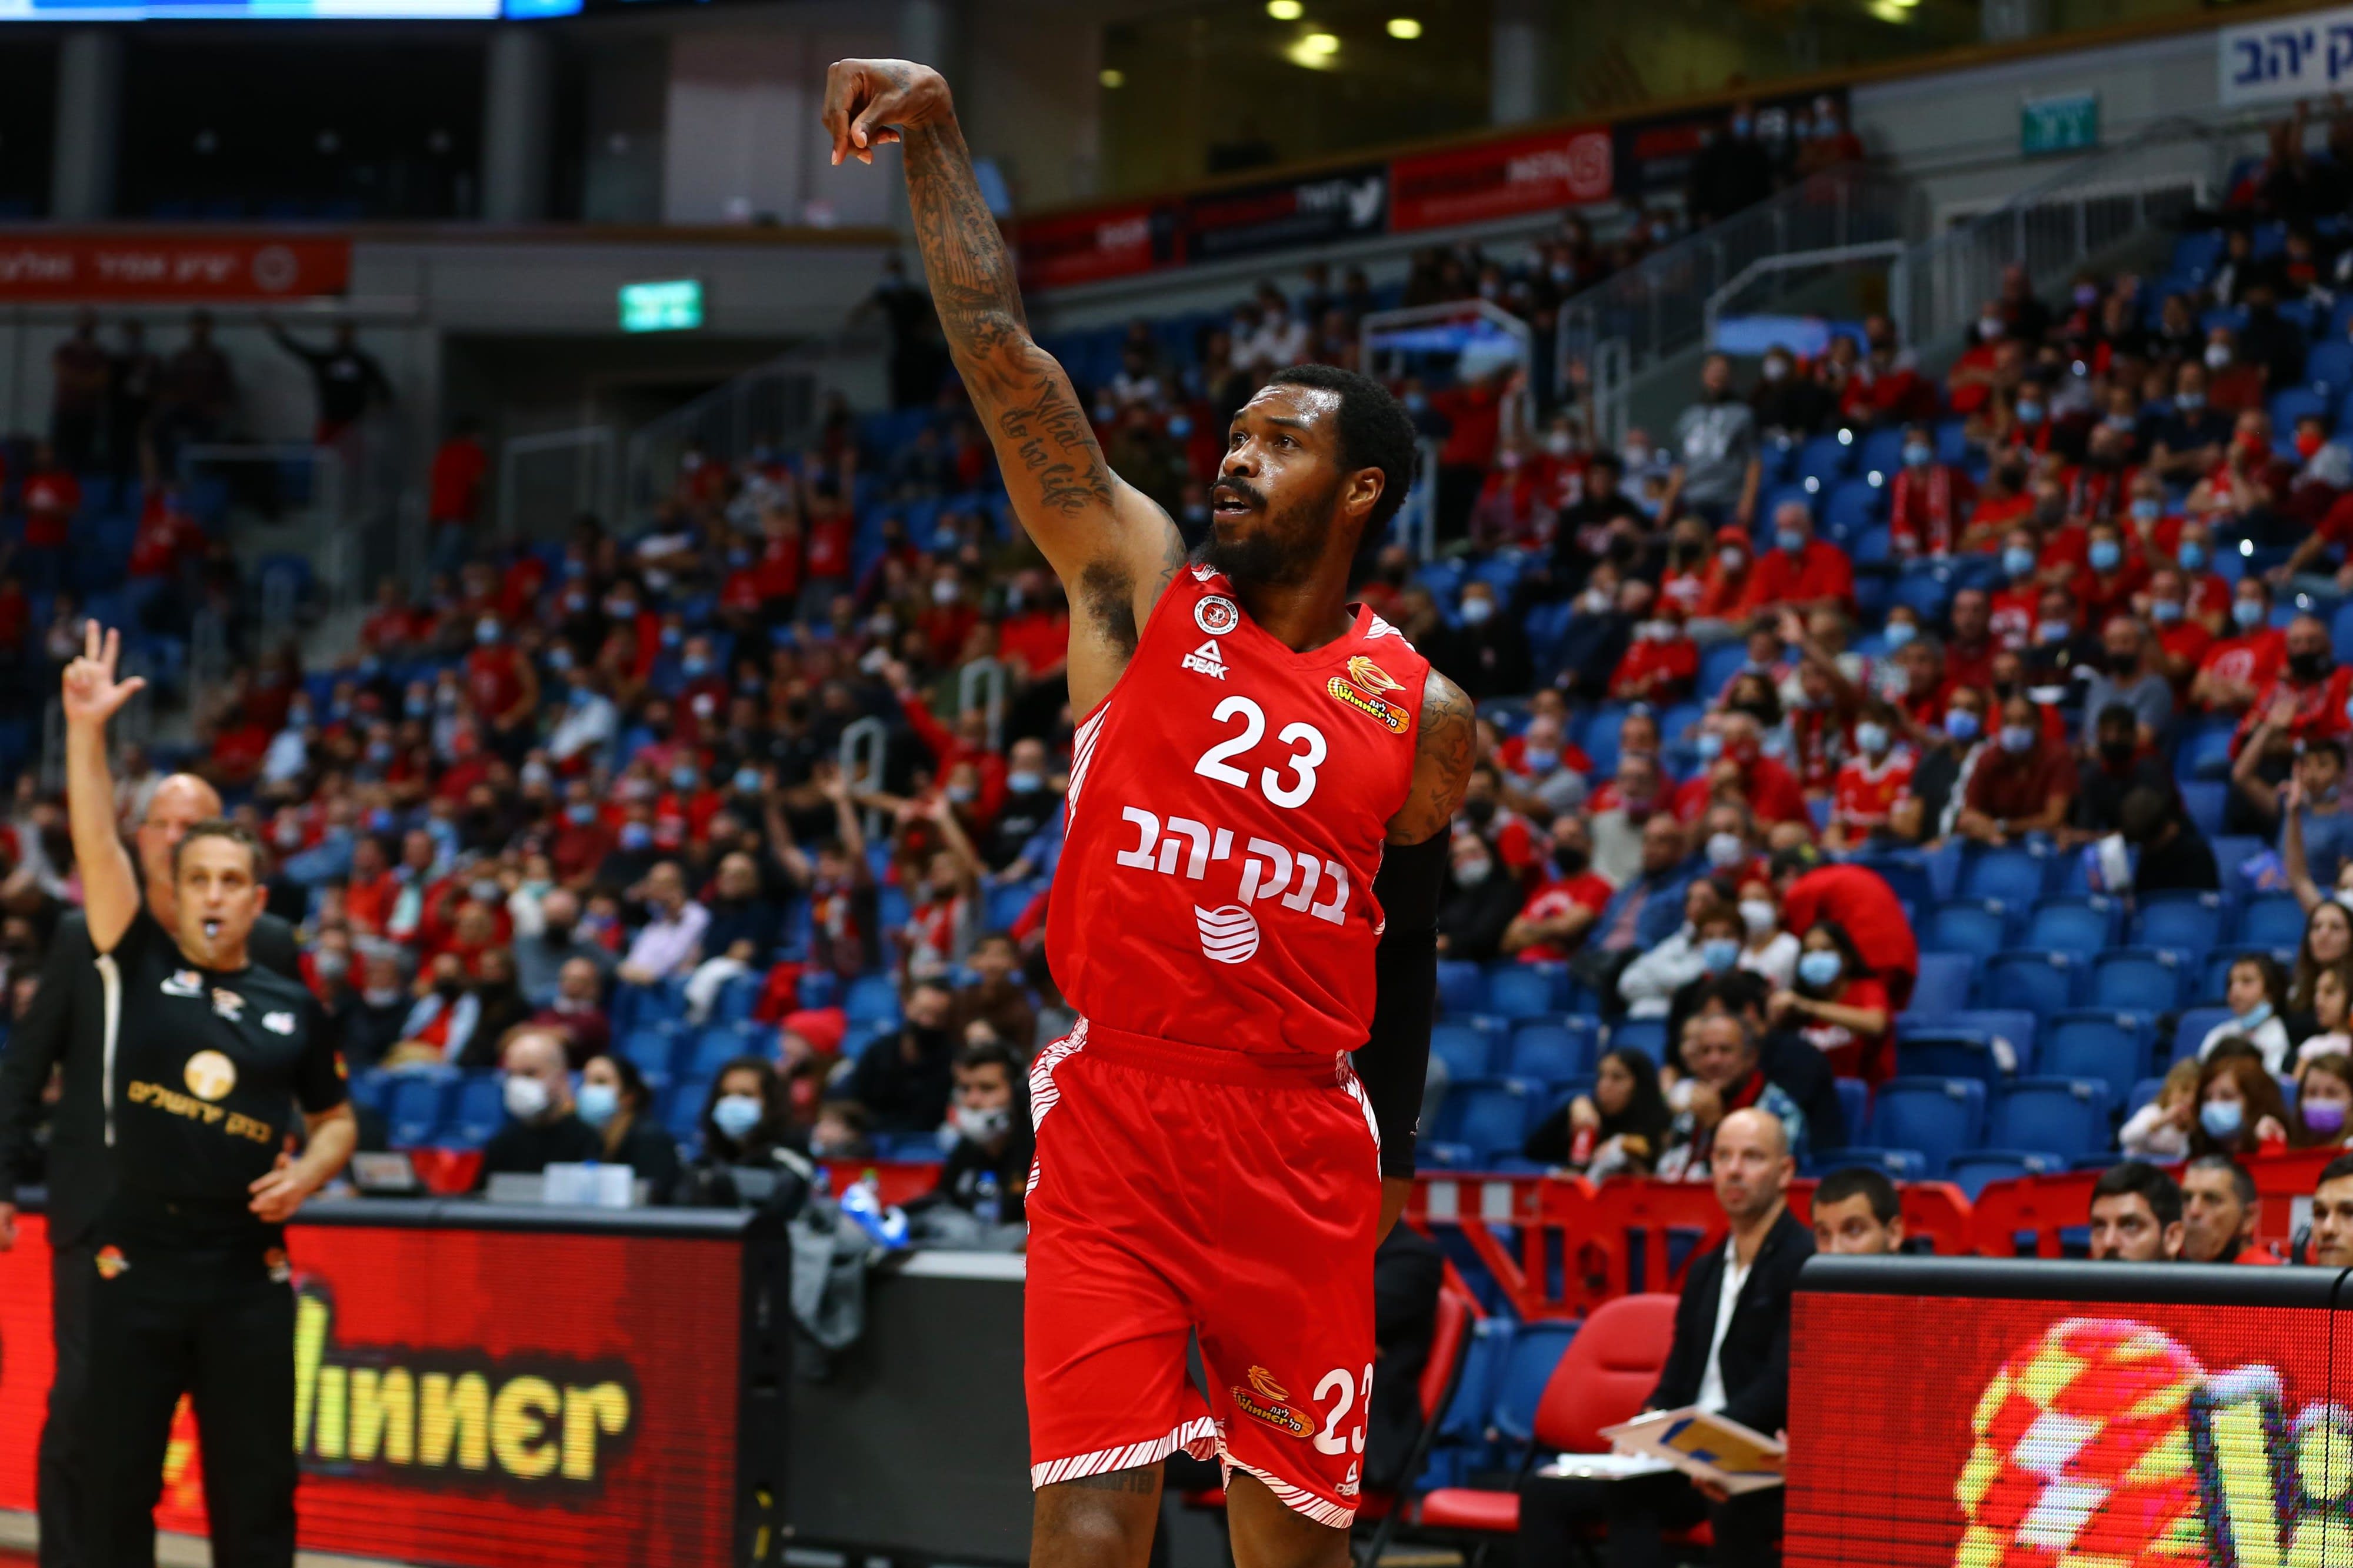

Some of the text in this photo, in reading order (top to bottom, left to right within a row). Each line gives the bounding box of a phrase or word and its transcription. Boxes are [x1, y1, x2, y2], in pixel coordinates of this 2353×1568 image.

[2234, 27, 2315, 84] יהב
[1001, 407, 1037, 439] do
[1019, 437, 1048, 472] in
[1181, 653, 1230, 680] PEAK
[1338, 685, 1385, 719] Winner
[1369, 699, 1387, 712] ליגת
[1385, 712, 1398, 727] סל
[1194, 695, 1328, 809] 23
[1116, 805, 1350, 926] בנק יהב
[1237, 1394, 1288, 1426] Winner
[1269, 1405, 1291, 1417] ליגת
[1288, 1419, 1302, 1432] סל
[1312, 1362, 1374, 1456] 23
